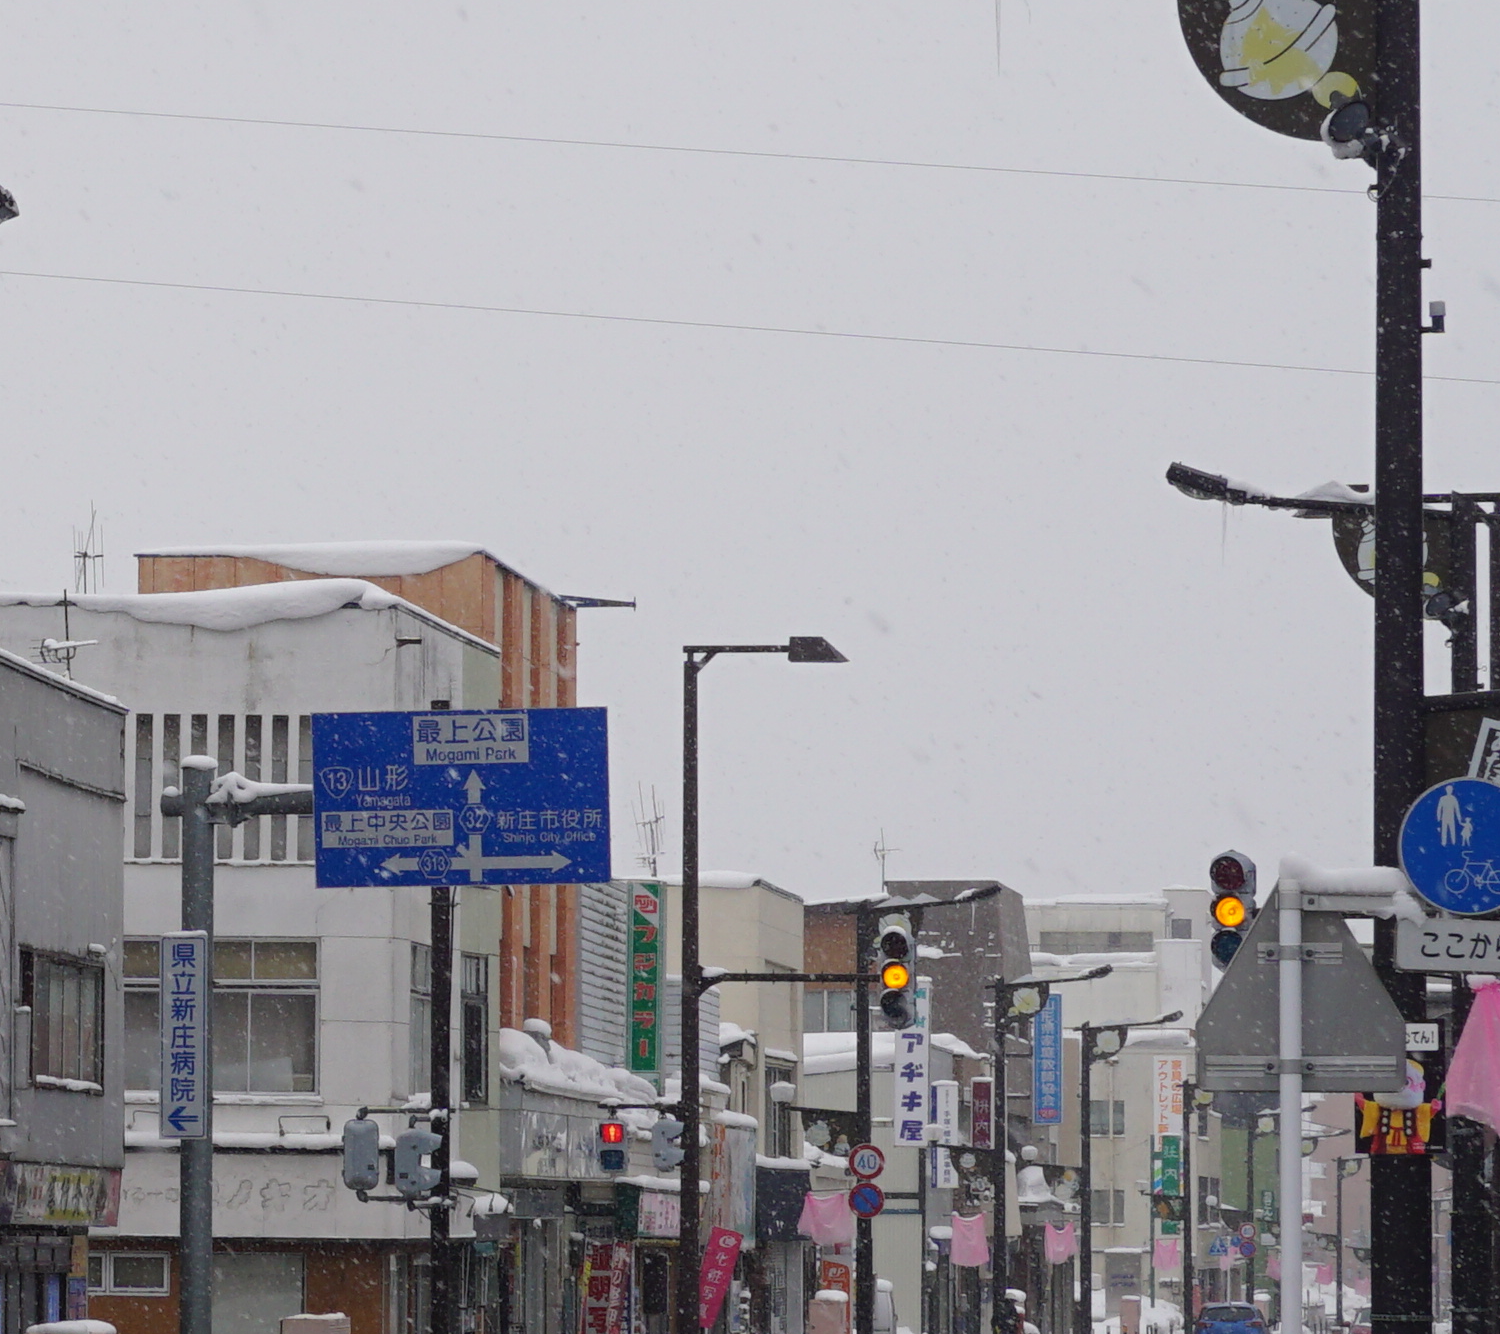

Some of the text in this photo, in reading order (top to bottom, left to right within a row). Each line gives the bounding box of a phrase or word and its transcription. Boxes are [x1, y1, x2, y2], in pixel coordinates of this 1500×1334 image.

[416, 718, 526, 746] 最上公園
[425, 746, 517, 763] Mogami Park
[326, 771, 349, 789] 13
[358, 764, 410, 792] 山形
[356, 793, 411, 808] Yamagata
[324, 812, 452, 835] 最上中央公園
[465, 810, 485, 829] 32
[497, 808, 603, 831] 新庄市役所
[338, 835, 379, 848] Mogami
[414, 834, 438, 845] Park
[540, 831, 561, 845] City
[564, 830, 597, 842] Office
[633, 924, 658, 1058] フジカラー
[169, 943, 197, 1103] 県立新庄病院
[899, 1032, 925, 1141] アヂキ屋
[857, 1153, 877, 1171] 40
